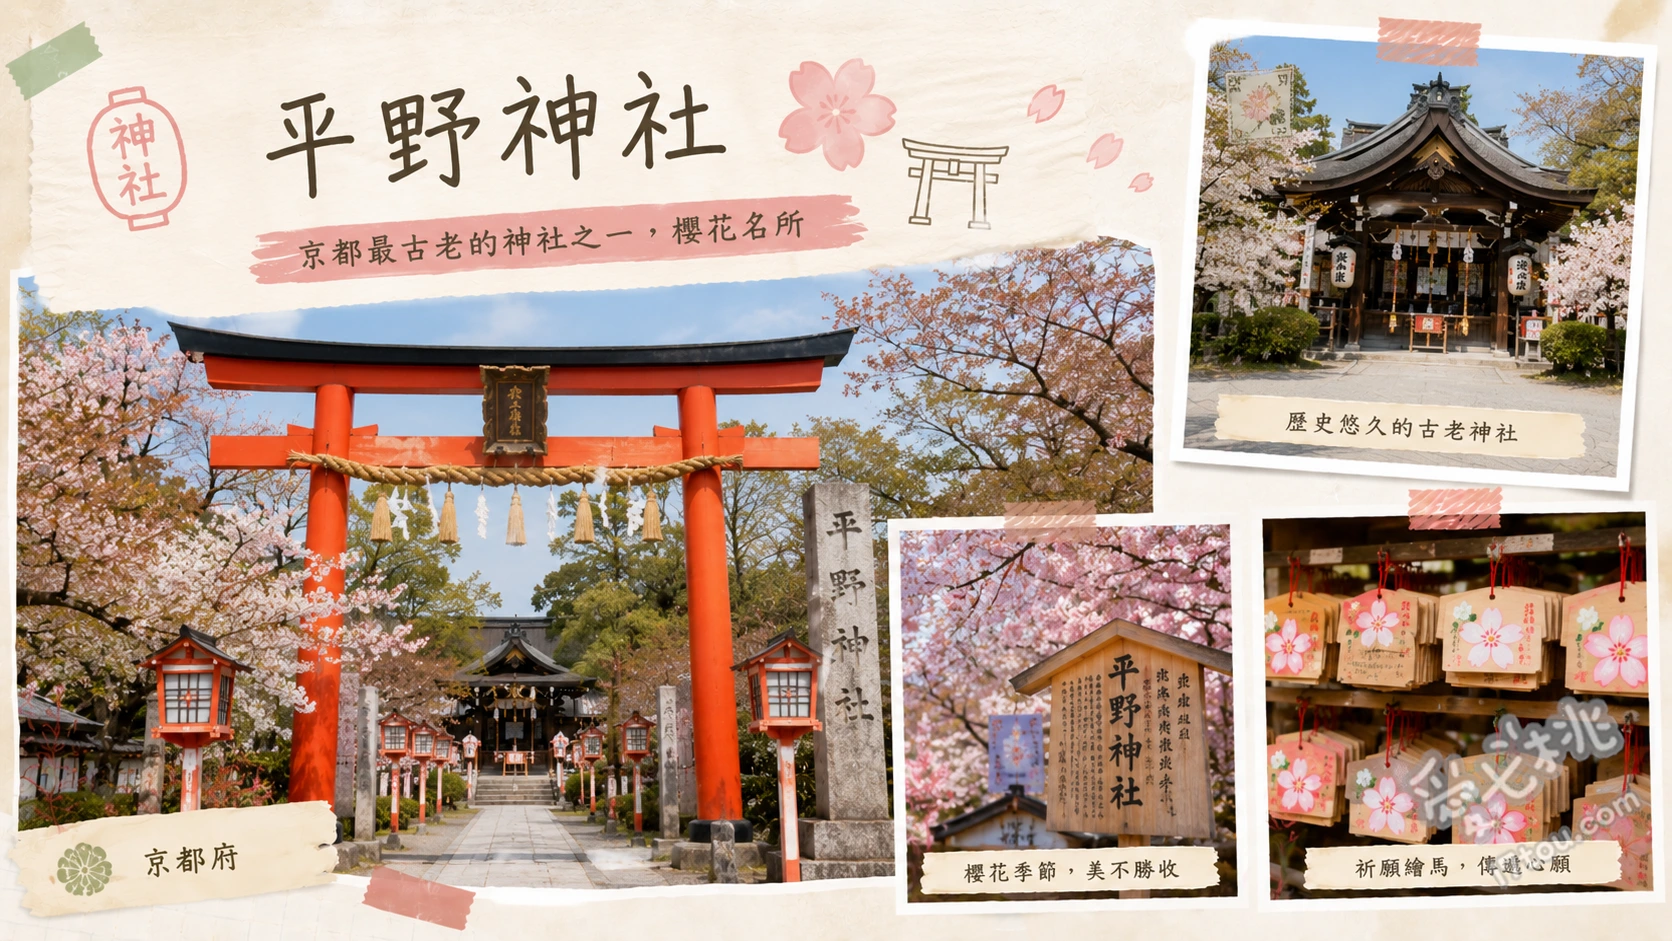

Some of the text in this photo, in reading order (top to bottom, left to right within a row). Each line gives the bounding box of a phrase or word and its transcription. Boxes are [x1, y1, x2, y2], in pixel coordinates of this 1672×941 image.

[826, 510, 874, 724] 平野神社
[1108, 653, 1143, 810] 平野神社
